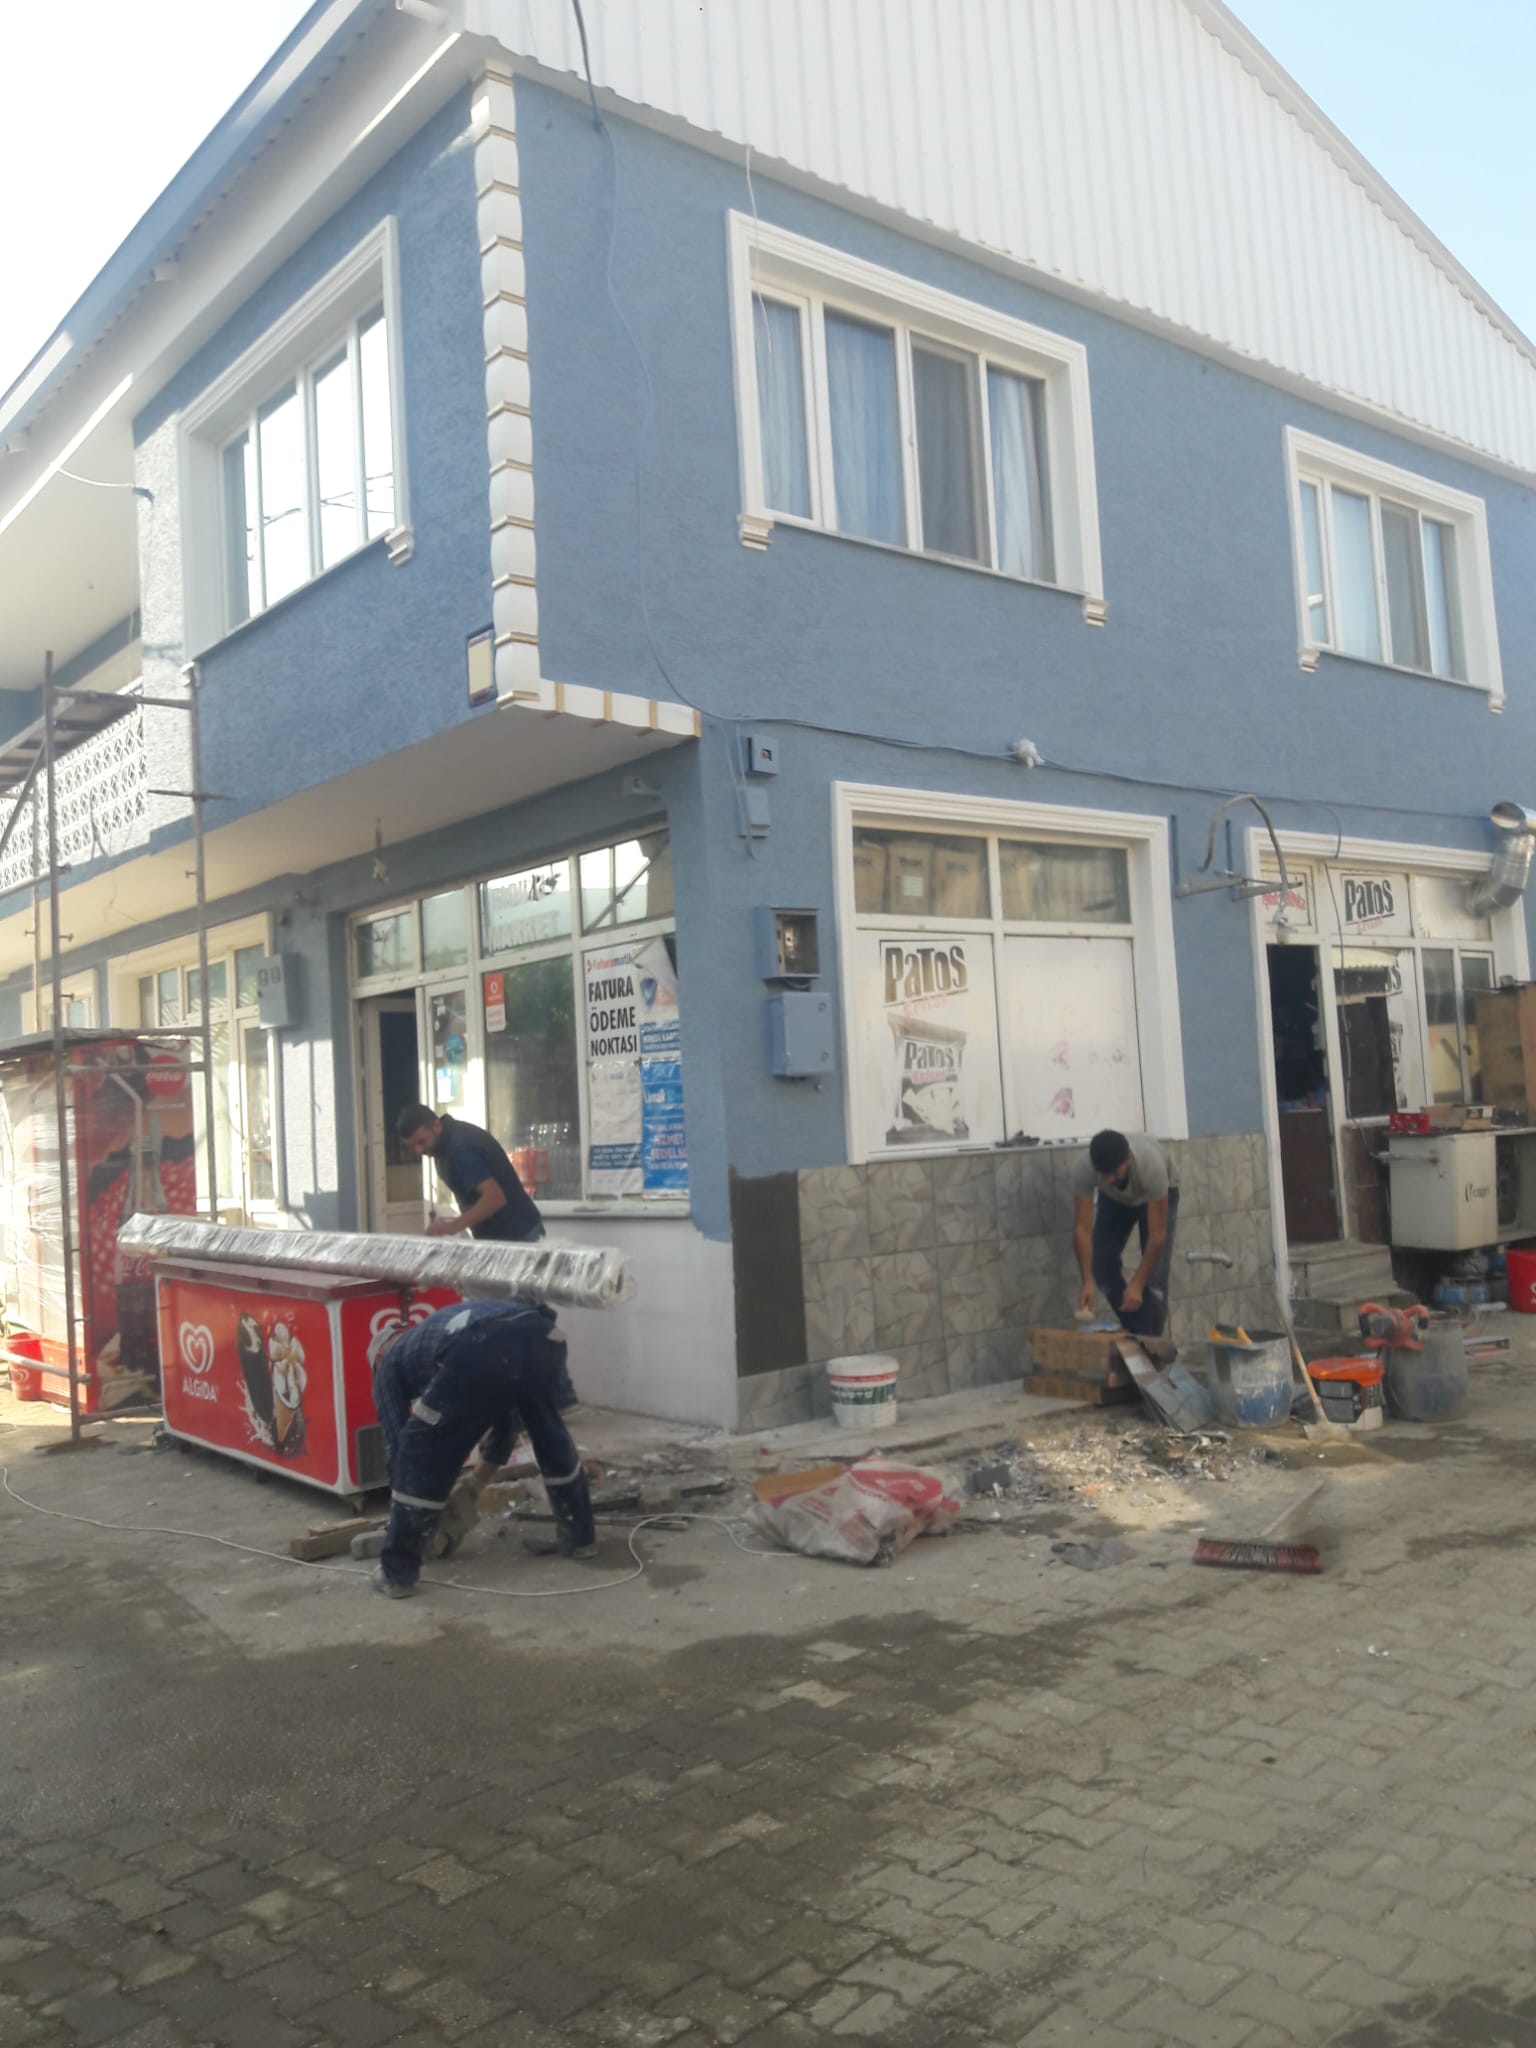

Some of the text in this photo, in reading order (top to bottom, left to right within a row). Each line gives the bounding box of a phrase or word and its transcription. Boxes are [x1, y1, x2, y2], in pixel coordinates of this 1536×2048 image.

[588, 976, 634, 1002] FATURA
[590, 1006, 636, 1032] ÖDEME
[591, 1034, 637, 1057] NOKTASI
